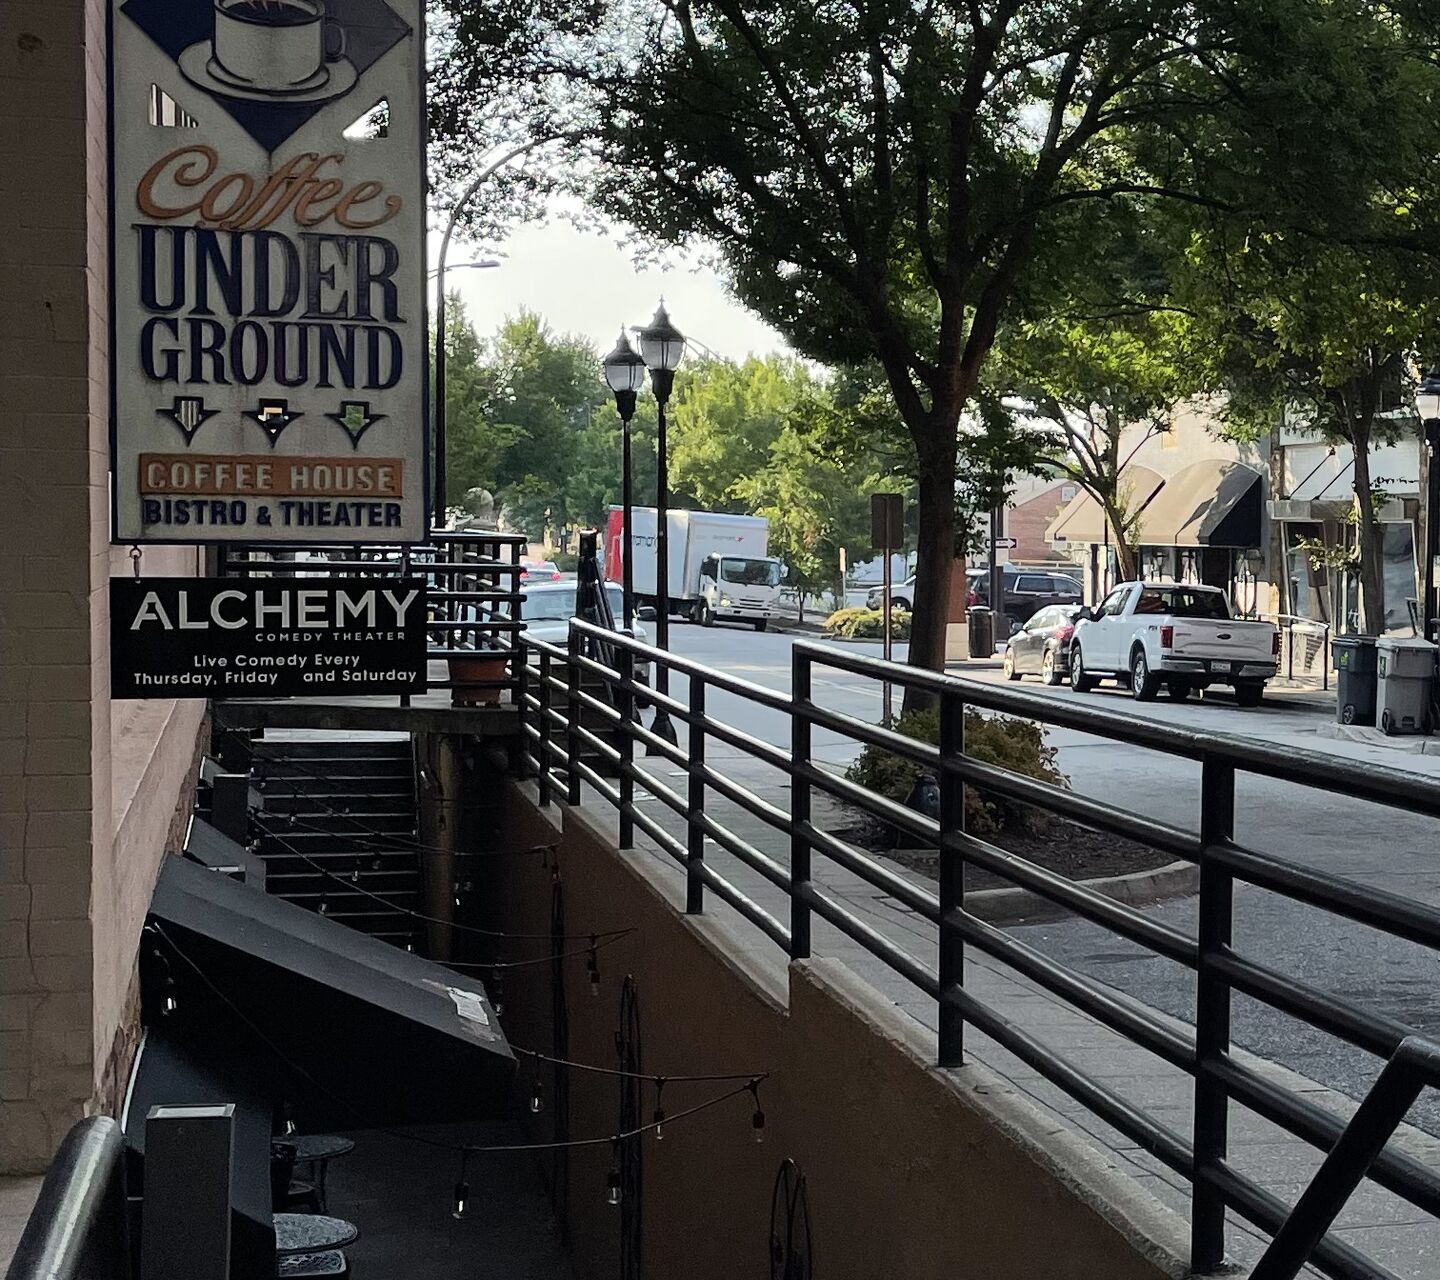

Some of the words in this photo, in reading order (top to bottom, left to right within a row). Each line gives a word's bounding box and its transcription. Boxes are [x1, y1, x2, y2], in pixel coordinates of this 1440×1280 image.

[137, 144, 403, 230] Coffee
[131, 223, 407, 322] UNDER
[140, 317, 404, 390] GROUND
[147, 462, 274, 490] COFFEE
[290, 464, 396, 492] HOUSE
[143, 499, 247, 526] BISTRO
[256, 505, 272, 527] &
[280, 501, 402, 527] THEATER
[130, 589, 419, 630] ALCHEMY
[255, 632, 323, 642] COMEDY
[333, 632, 406, 641] THEATER
[193, 655, 228, 667] Live
[235, 654, 308, 669] Comedy
[314, 654, 361, 668] Every
[134, 672, 218, 686] Thursday,
[225, 671, 279, 686] Friday
[303, 670, 336, 682] and
[342, 669, 418, 683] Saturday
